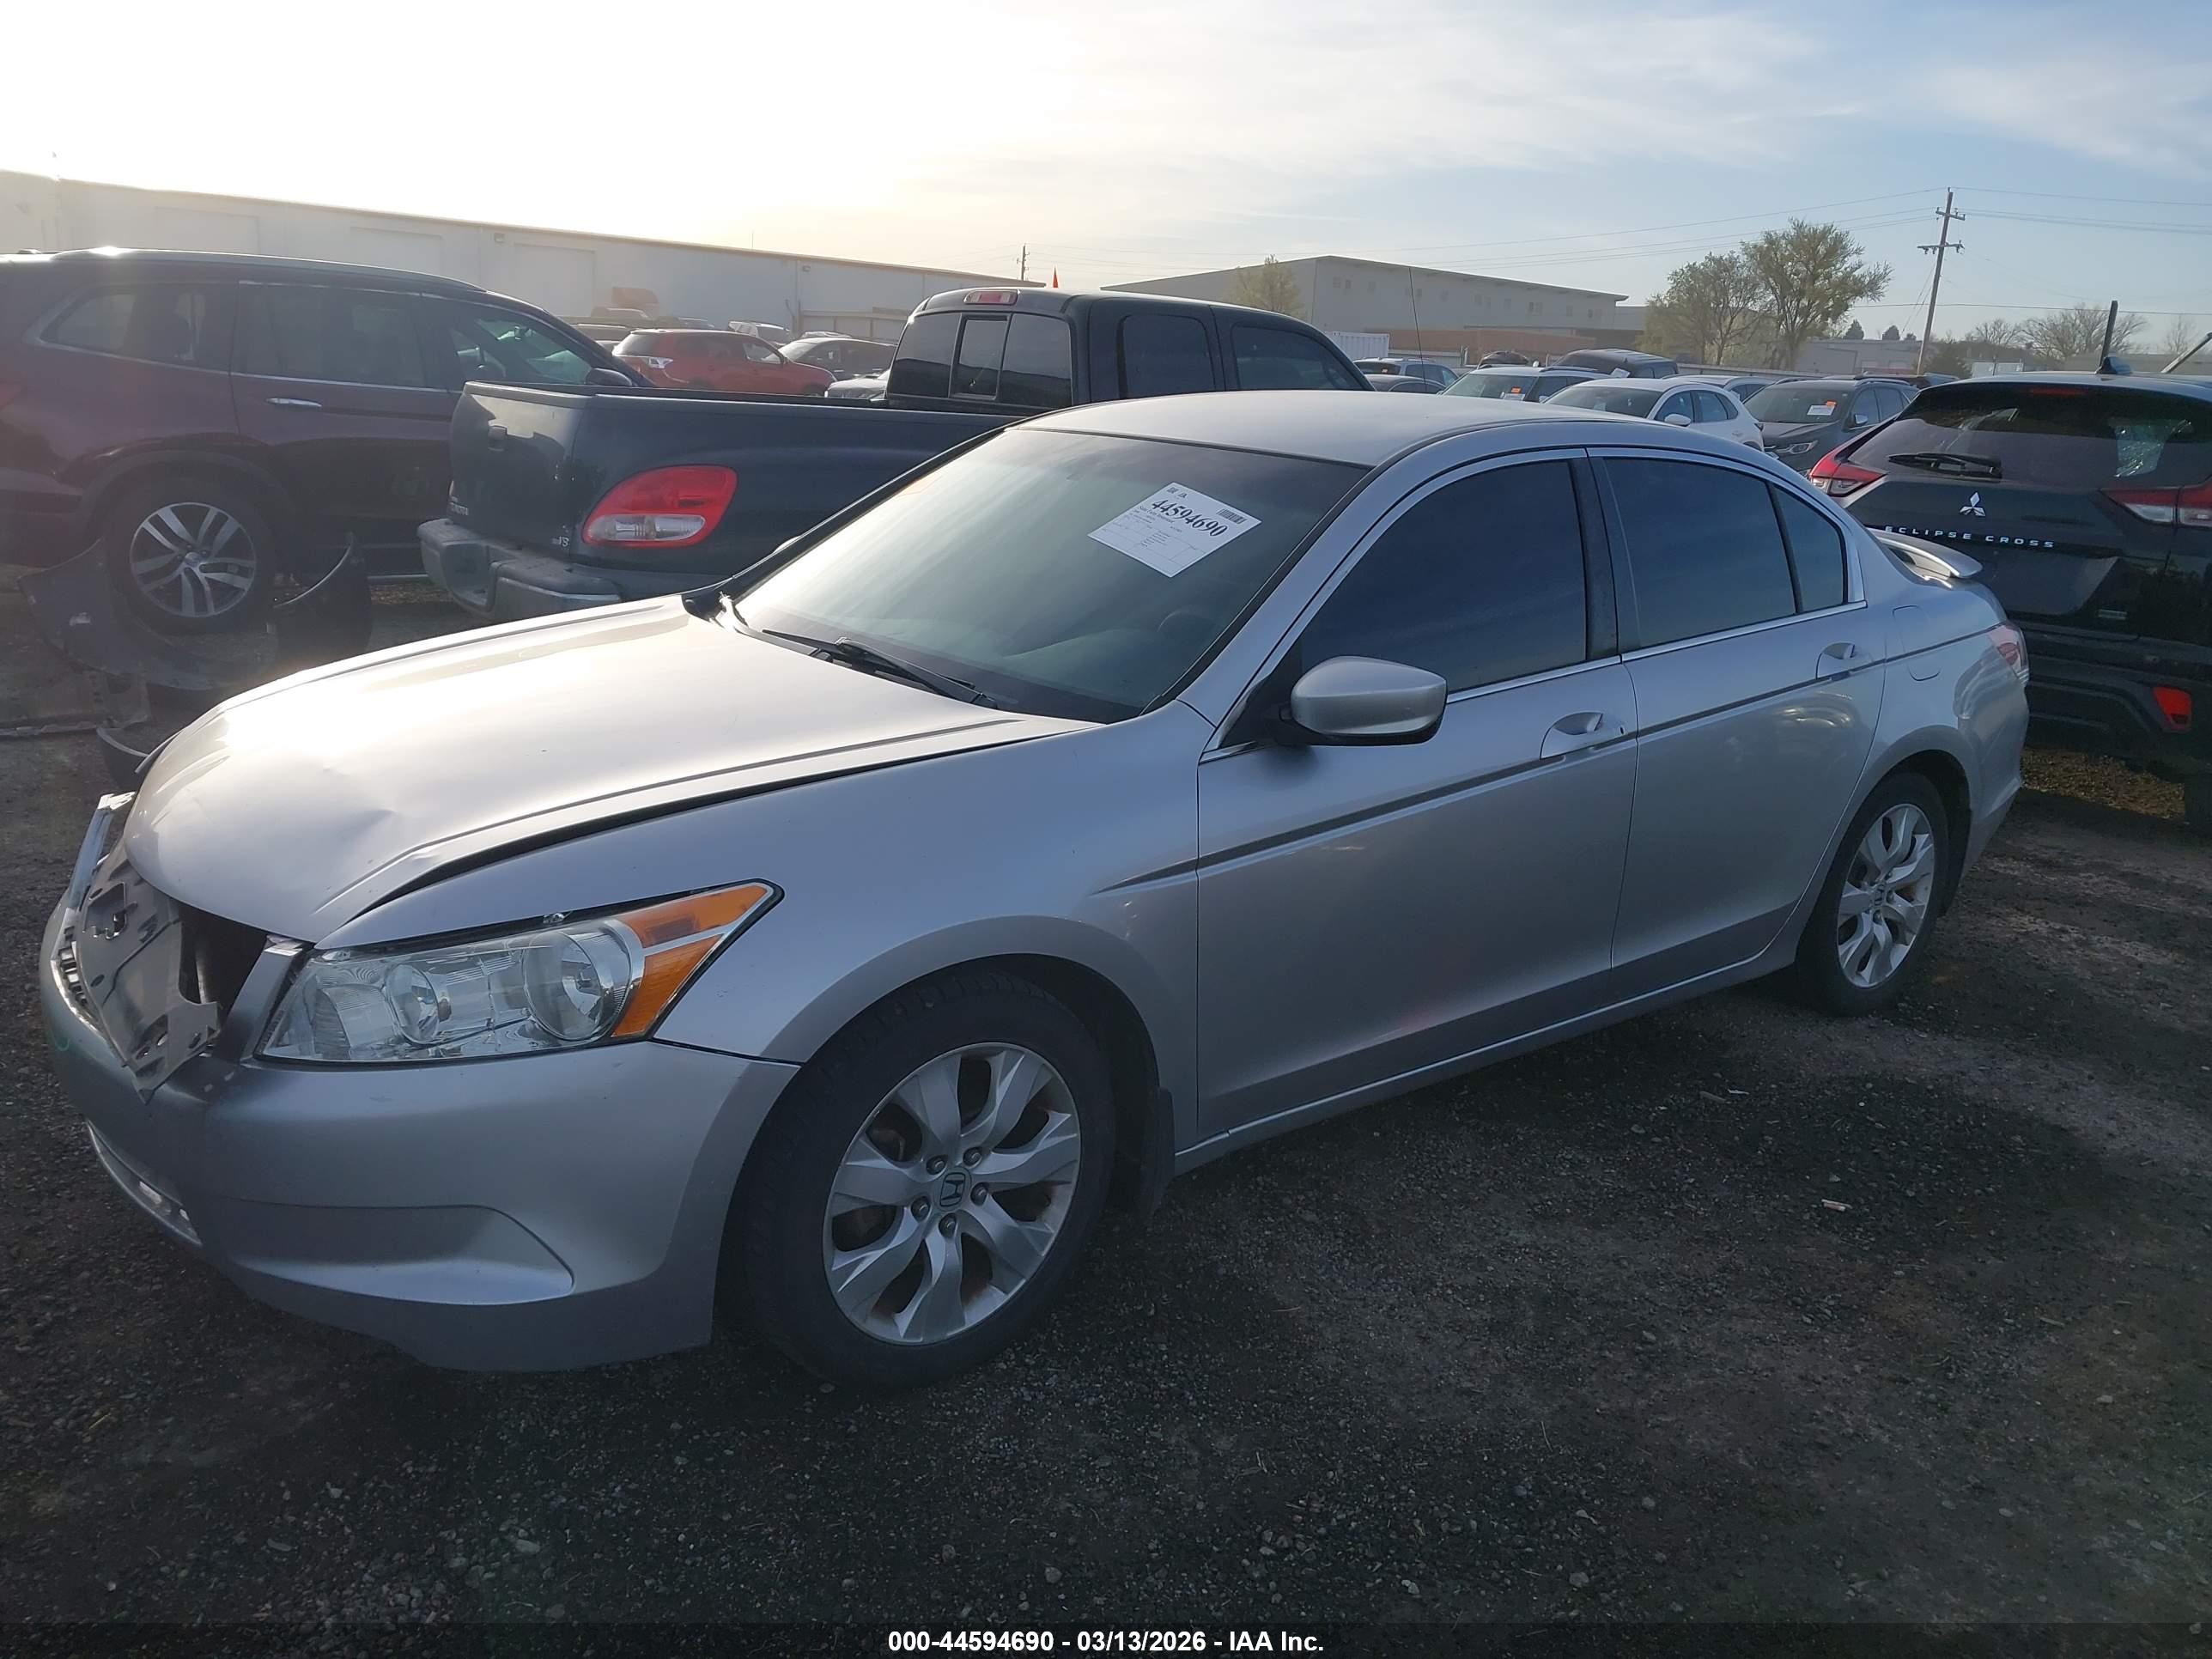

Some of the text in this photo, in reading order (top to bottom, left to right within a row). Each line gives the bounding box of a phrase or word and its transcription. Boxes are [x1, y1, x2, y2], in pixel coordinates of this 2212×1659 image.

[1152, 500, 1228, 537] 44594690
[1885, 526, 2054, 548] ECLIPSE CROSS
